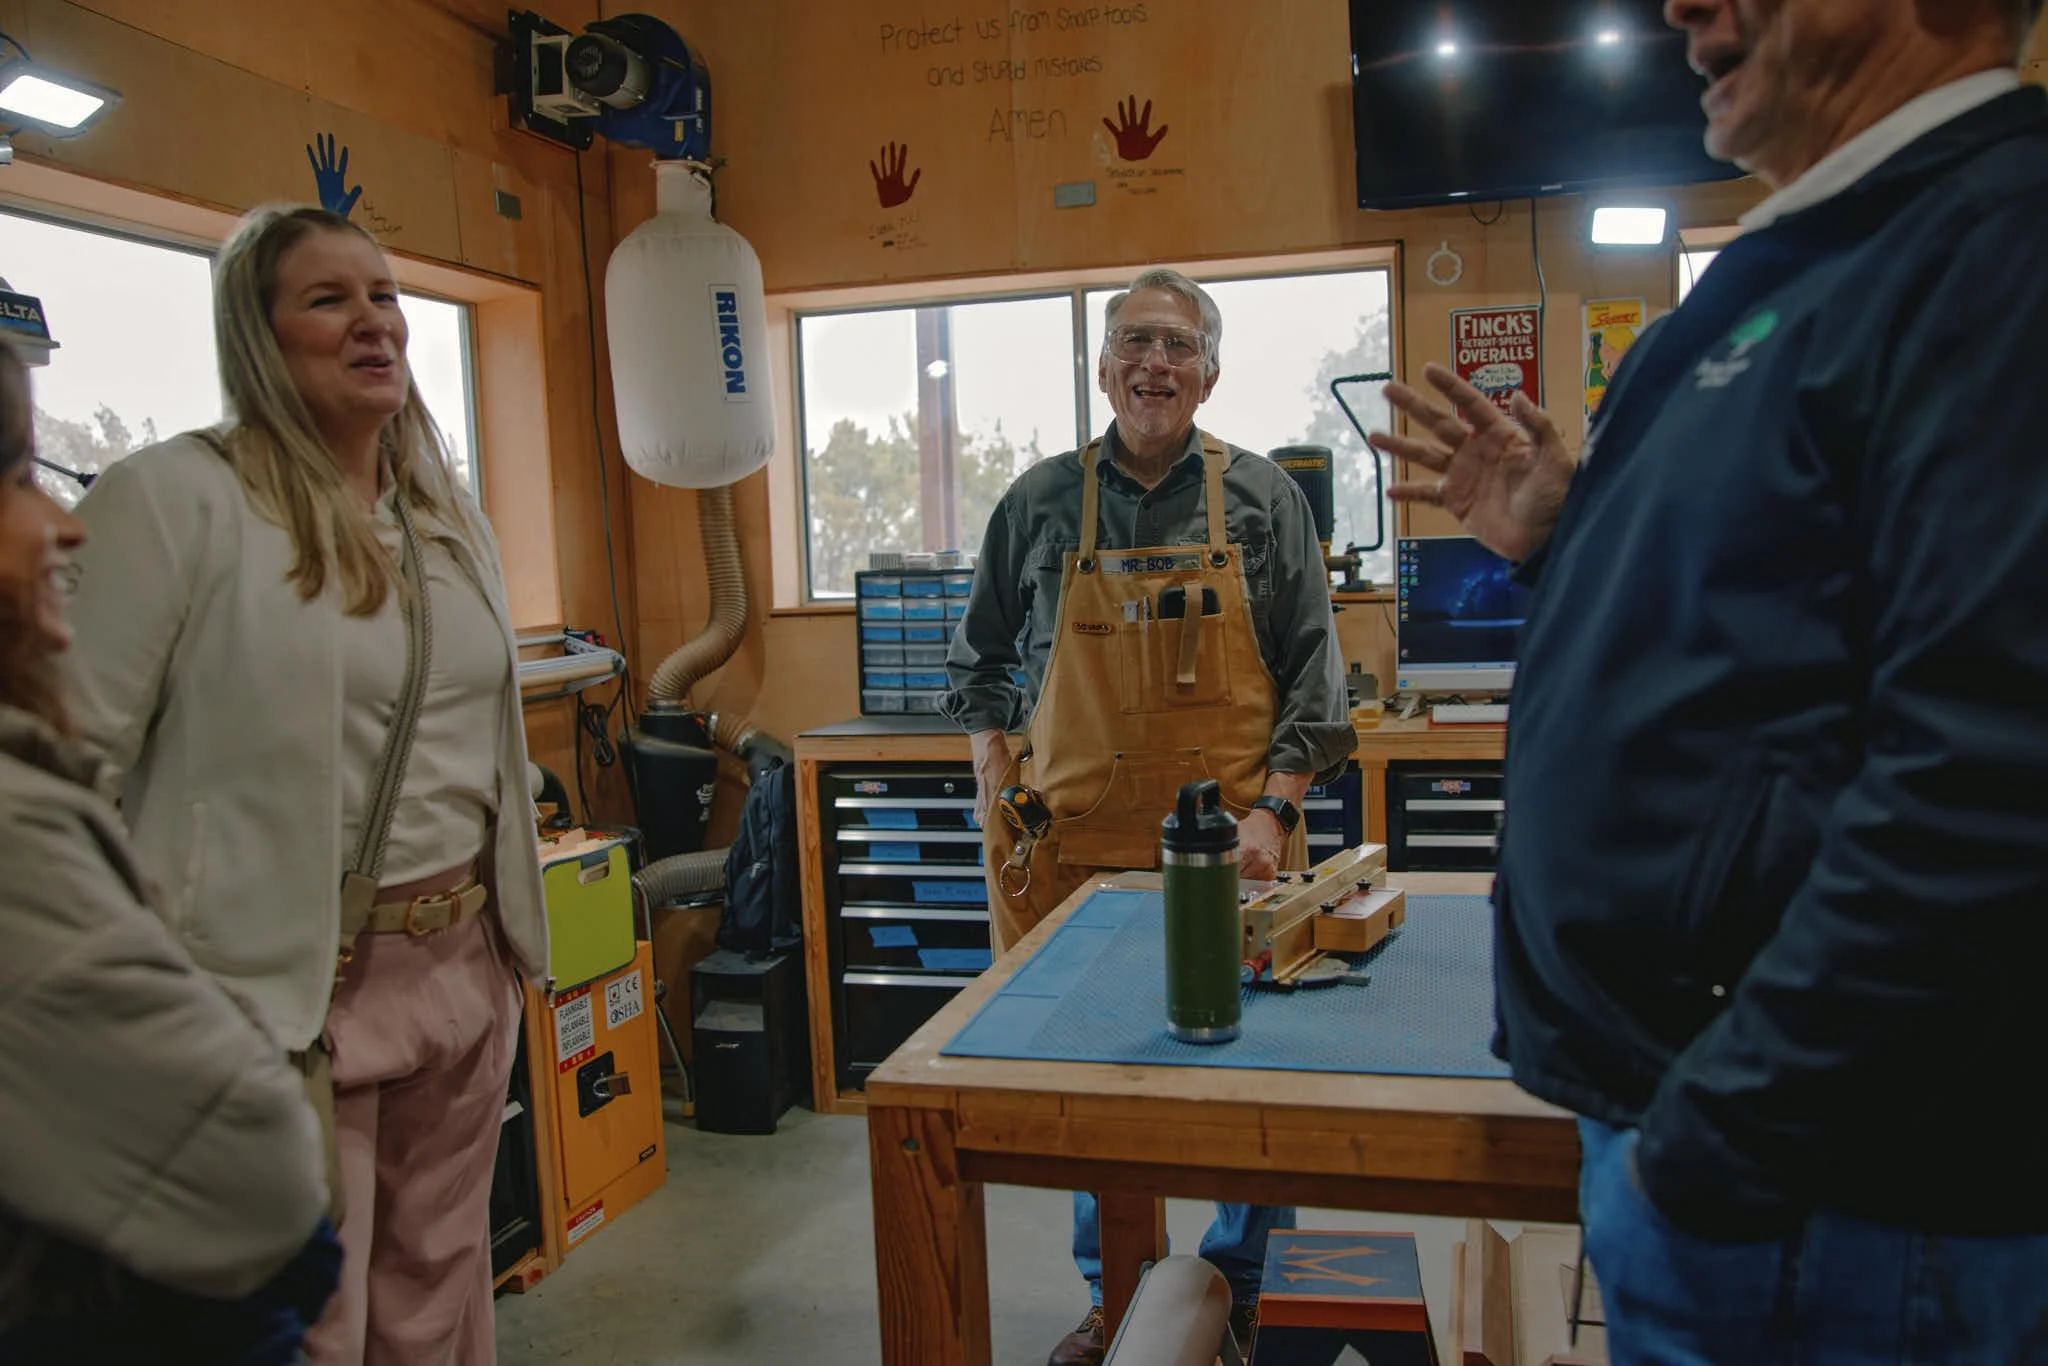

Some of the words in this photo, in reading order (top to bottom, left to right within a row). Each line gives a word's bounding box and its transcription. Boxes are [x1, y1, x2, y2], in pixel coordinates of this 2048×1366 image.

[880, 16, 963, 55] Protect
[1007, 9, 1050, 34] from
[1104, 2, 1148, 25] tools
[926, 65, 964, 87] and
[1459, 312, 1534, 338] FINCK'S
[716, 292, 746, 393] RIKON
[1459, 346, 1534, 365] OVERALLS
[1147, 557, 1174, 571] BOB
[610, 1000, 640, 1024] OSHA
